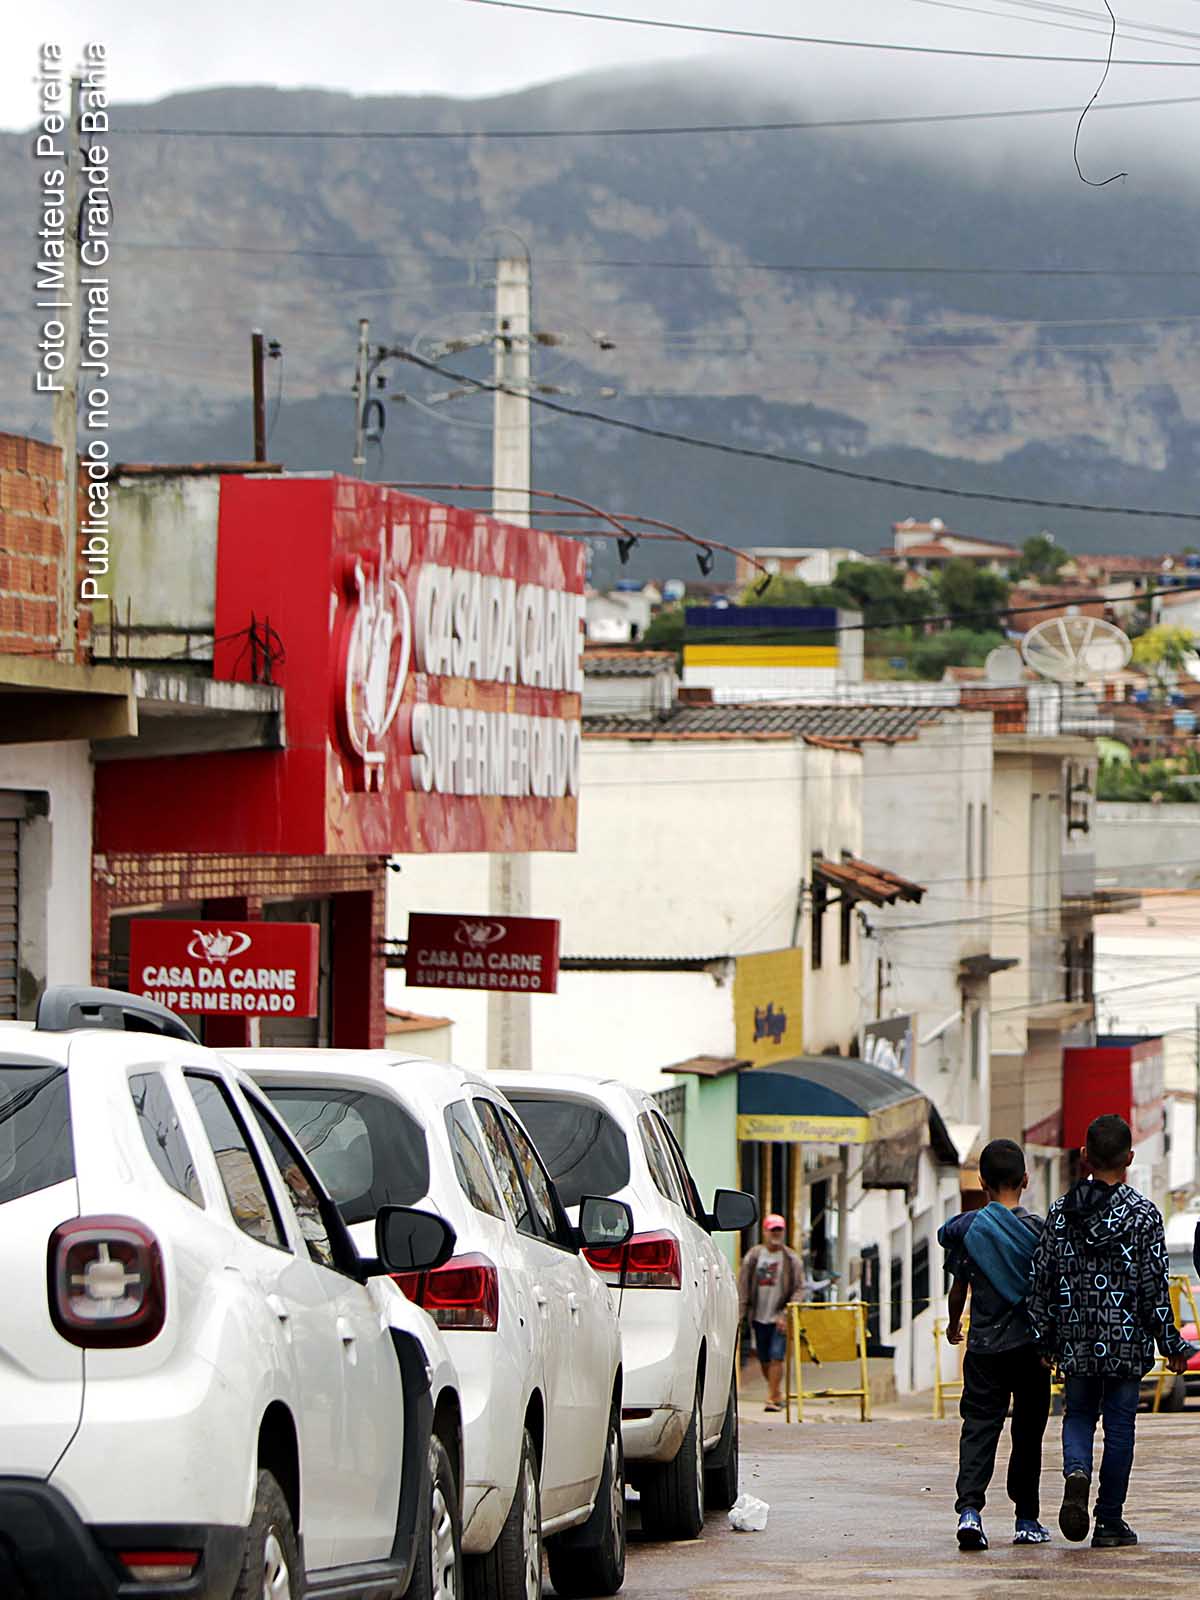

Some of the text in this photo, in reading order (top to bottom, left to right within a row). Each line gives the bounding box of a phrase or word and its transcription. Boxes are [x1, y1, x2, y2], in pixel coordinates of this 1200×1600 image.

[415, 562, 586, 694] CASA DA CARNE
[411, 703, 581, 798] SUPERMERCADO
[417, 950, 543, 971] CASA DA CARNE
[142, 966, 296, 990] CASA DA CARNE
[416, 970, 541, 989] SUPERMERCADO
